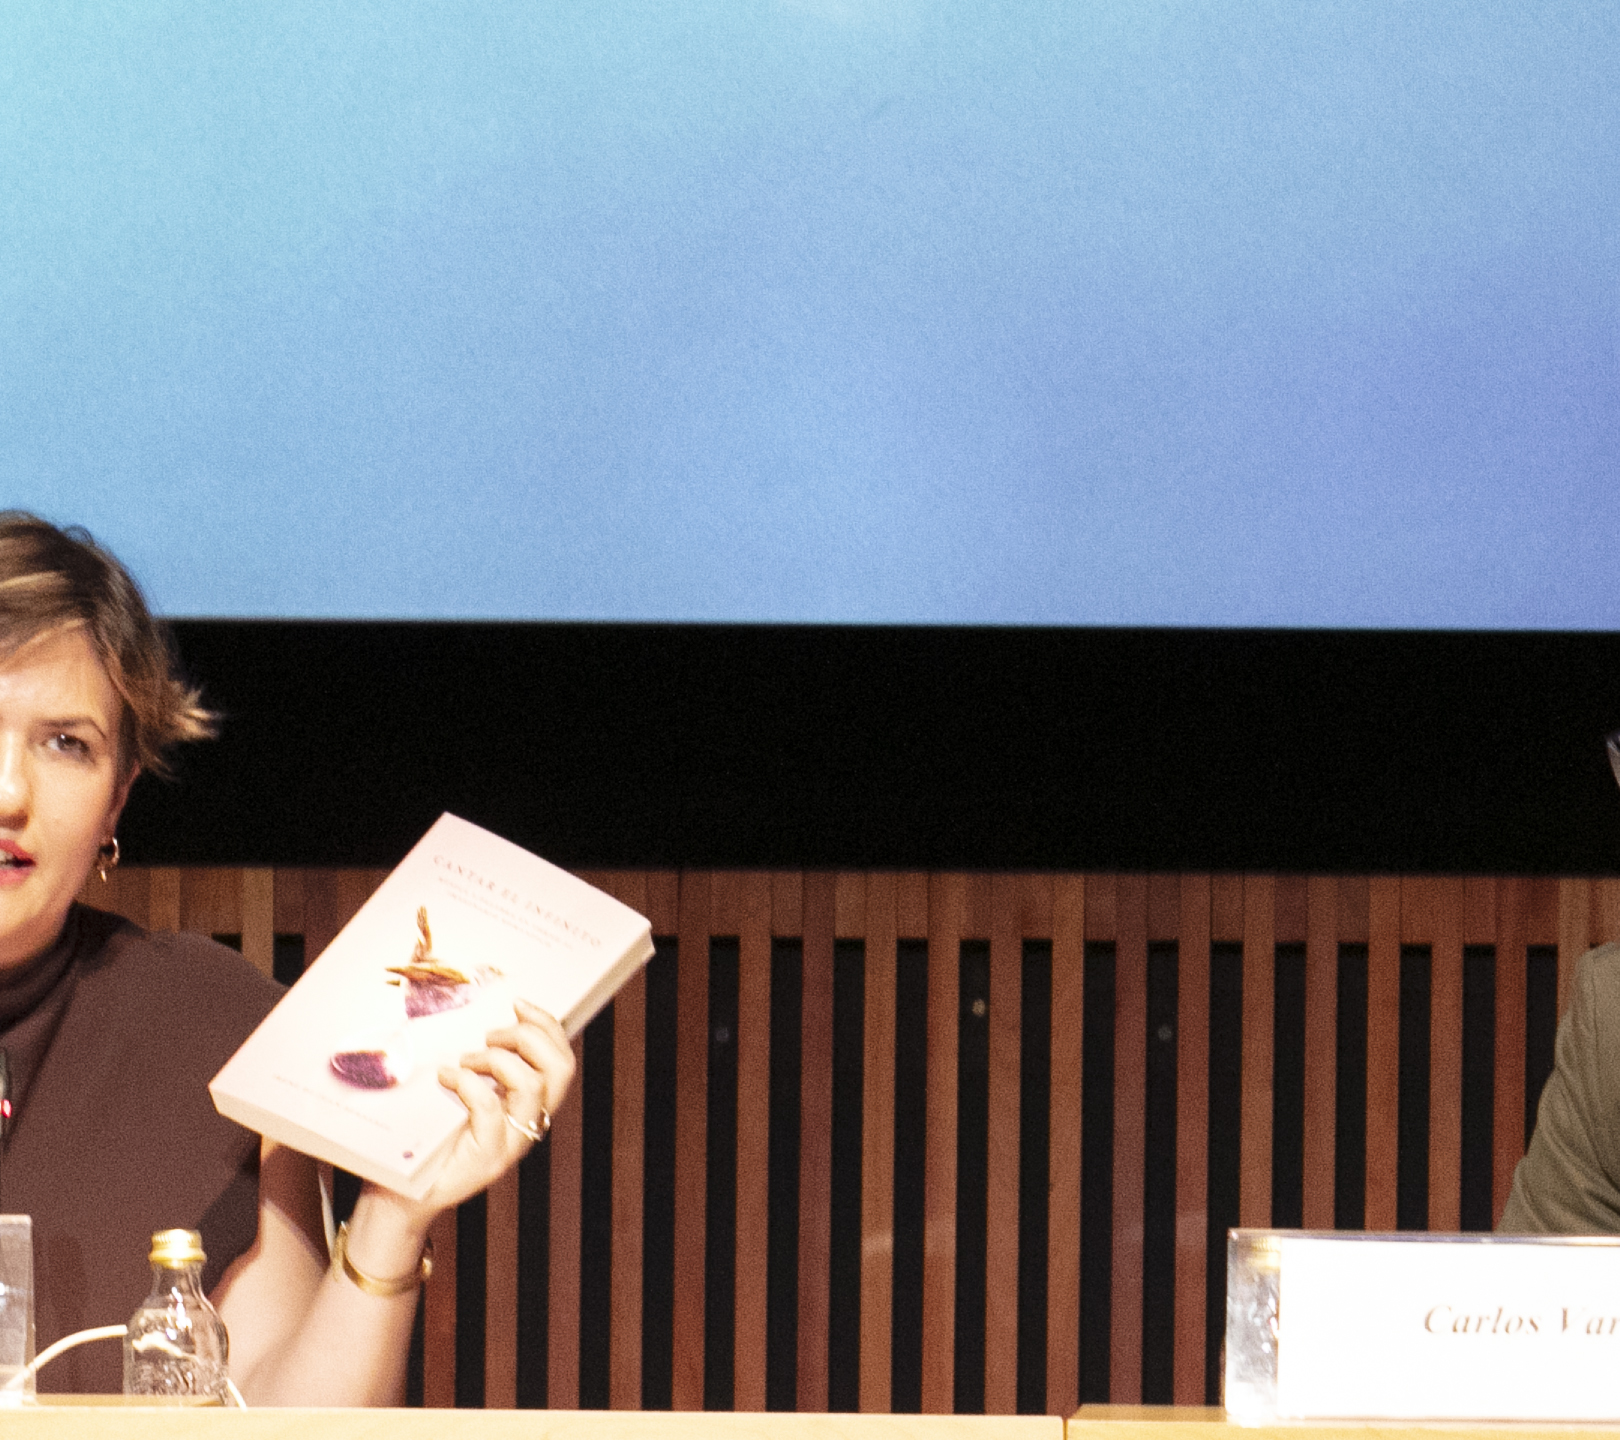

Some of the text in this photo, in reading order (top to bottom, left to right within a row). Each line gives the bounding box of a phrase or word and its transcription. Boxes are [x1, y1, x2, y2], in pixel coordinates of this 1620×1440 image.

[433, 855, 496, 892] CANTAR
[525, 900, 602, 947] INFINITO
[1423, 1304, 1541, 1336] Carlos
